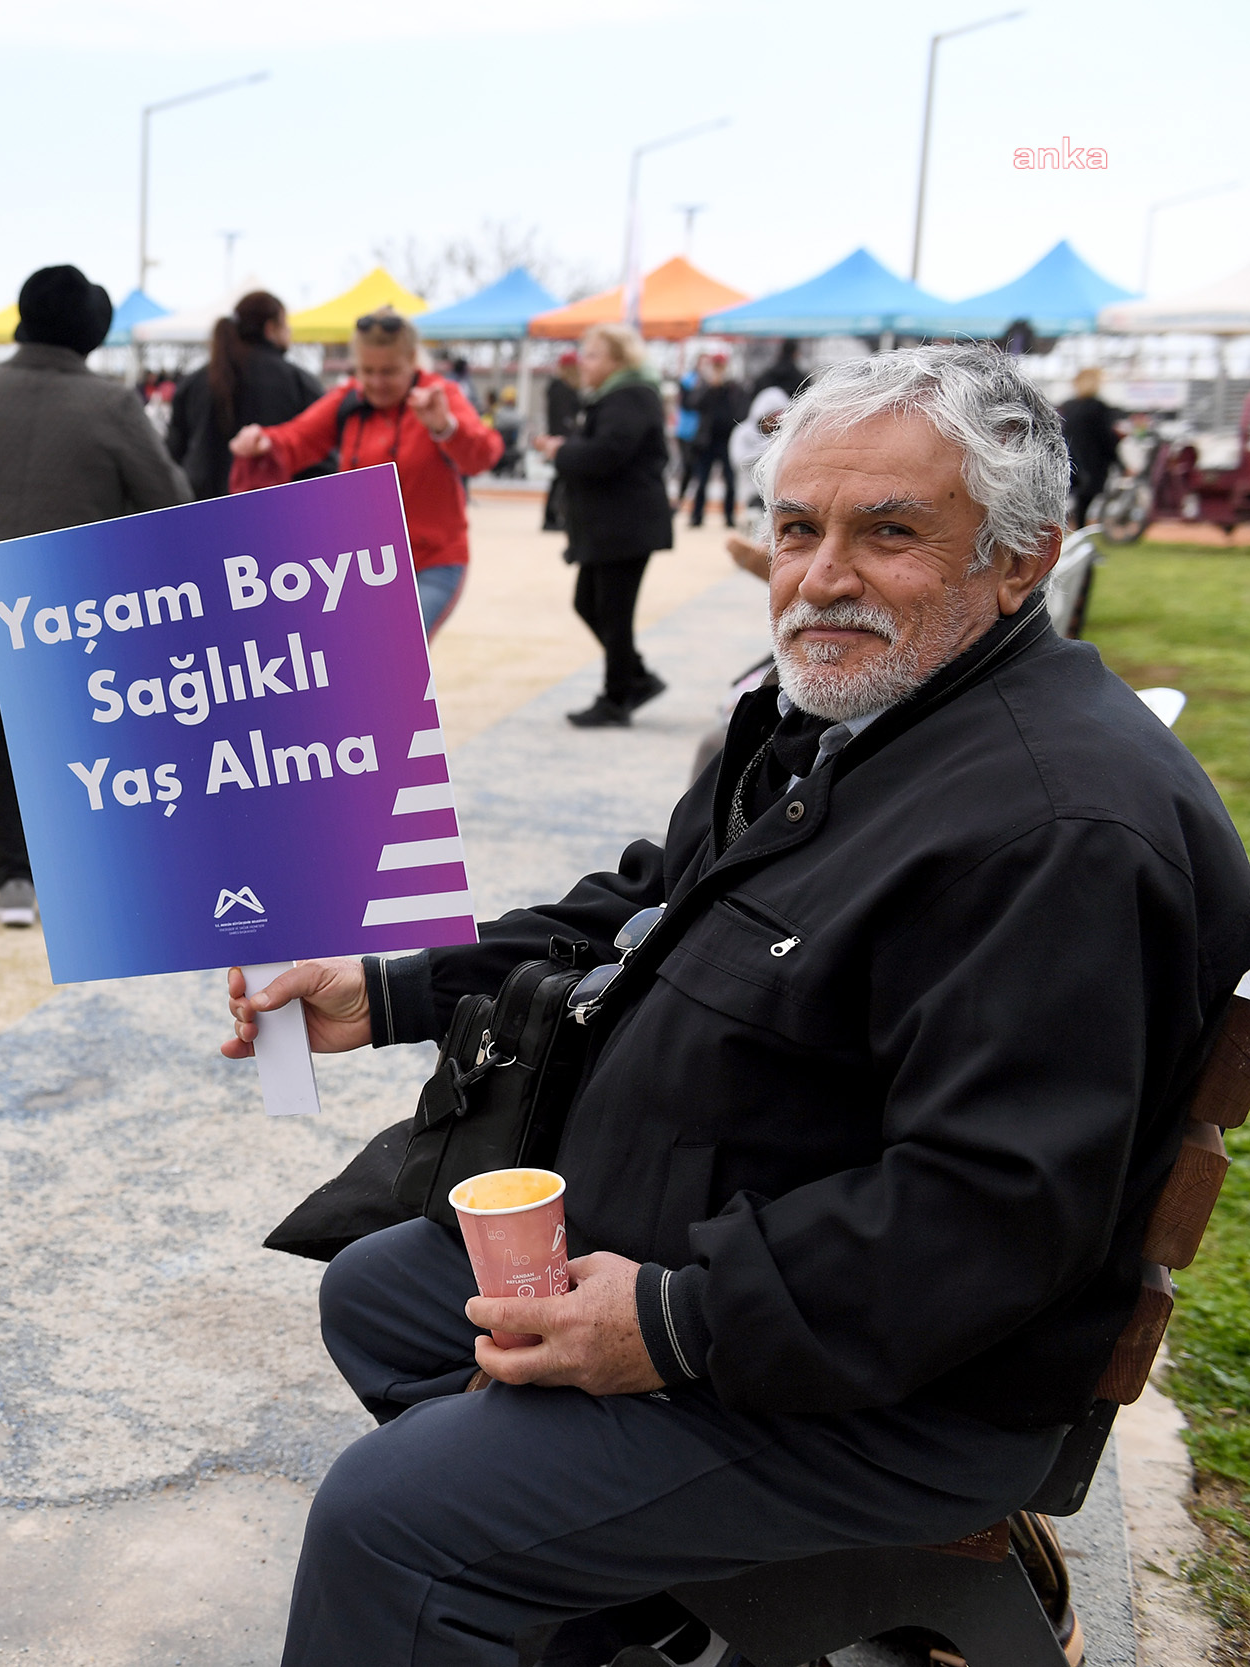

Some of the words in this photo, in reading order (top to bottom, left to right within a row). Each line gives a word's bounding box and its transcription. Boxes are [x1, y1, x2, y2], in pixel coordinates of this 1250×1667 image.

[223, 544, 398, 613] Boyu
[87, 632, 330, 726] Sağlıklı
[67, 757, 183, 818] Yaş
[205, 729, 379, 795] Alma
